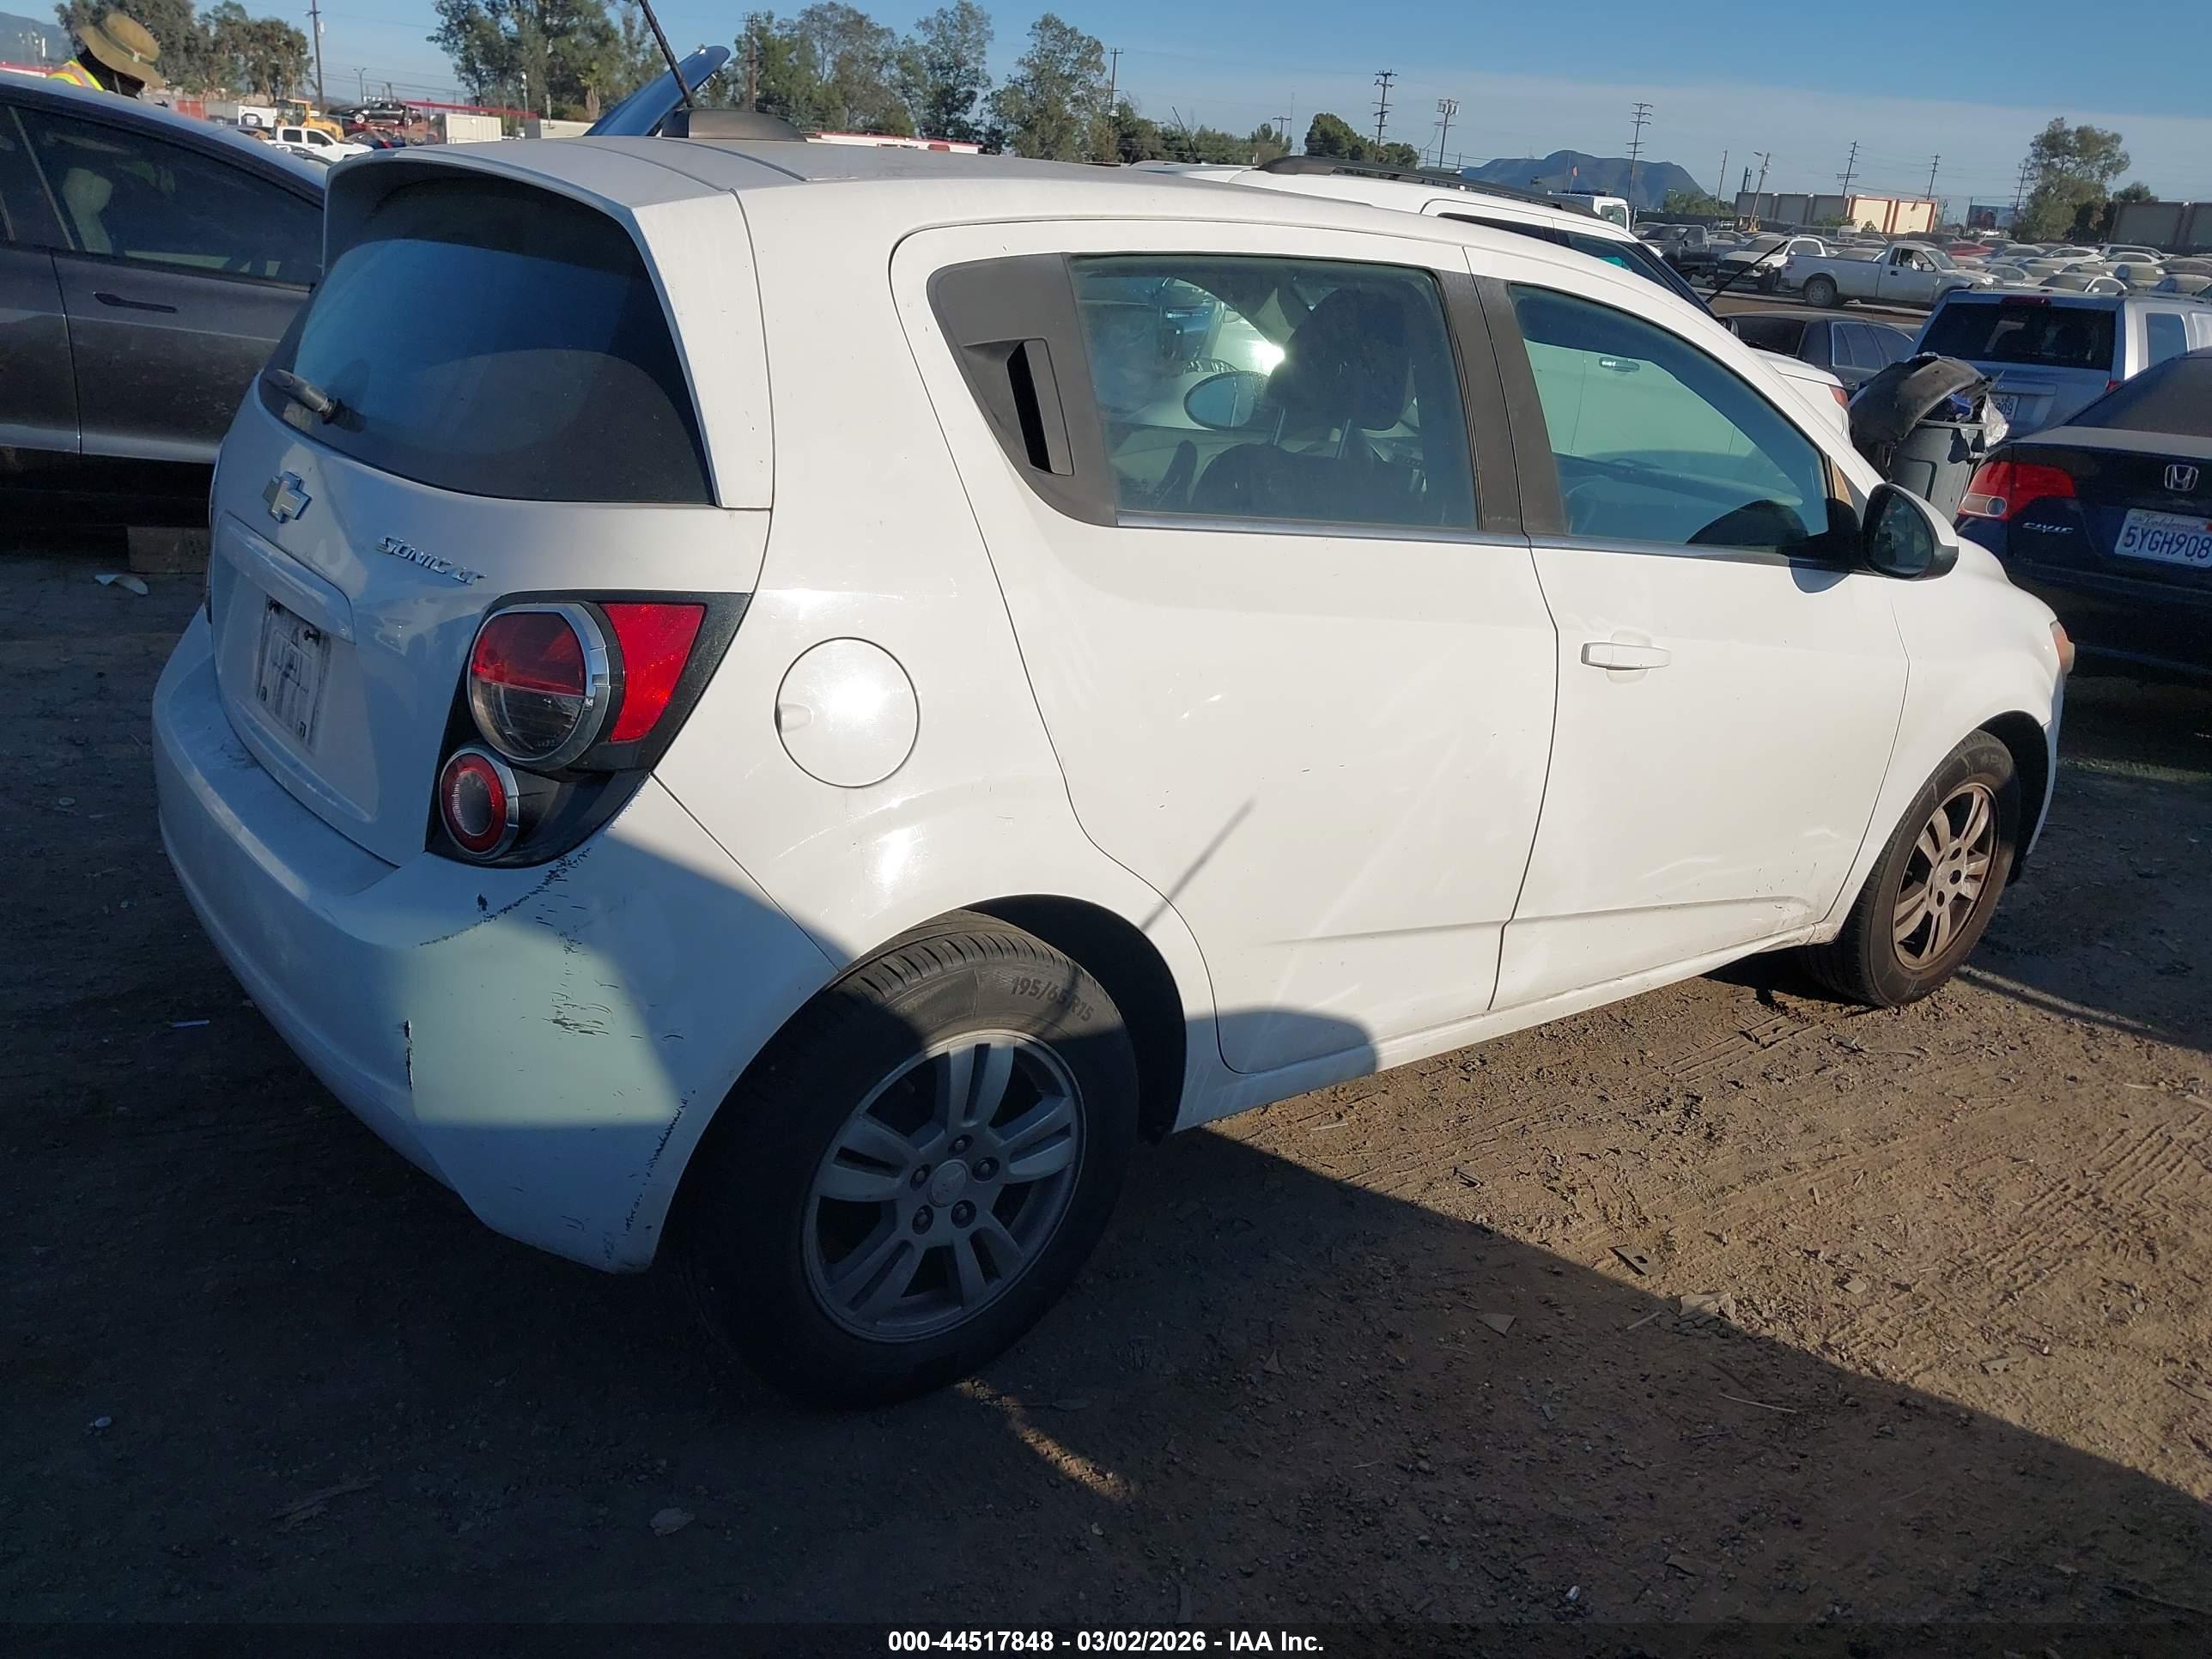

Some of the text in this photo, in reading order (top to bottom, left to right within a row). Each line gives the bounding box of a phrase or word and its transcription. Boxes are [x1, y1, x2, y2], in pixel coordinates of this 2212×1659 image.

[2021, 521, 2074, 535] CIVIC
[2123, 525, 2212, 559] 5YGH908
[377, 536, 453, 574] SONIC
